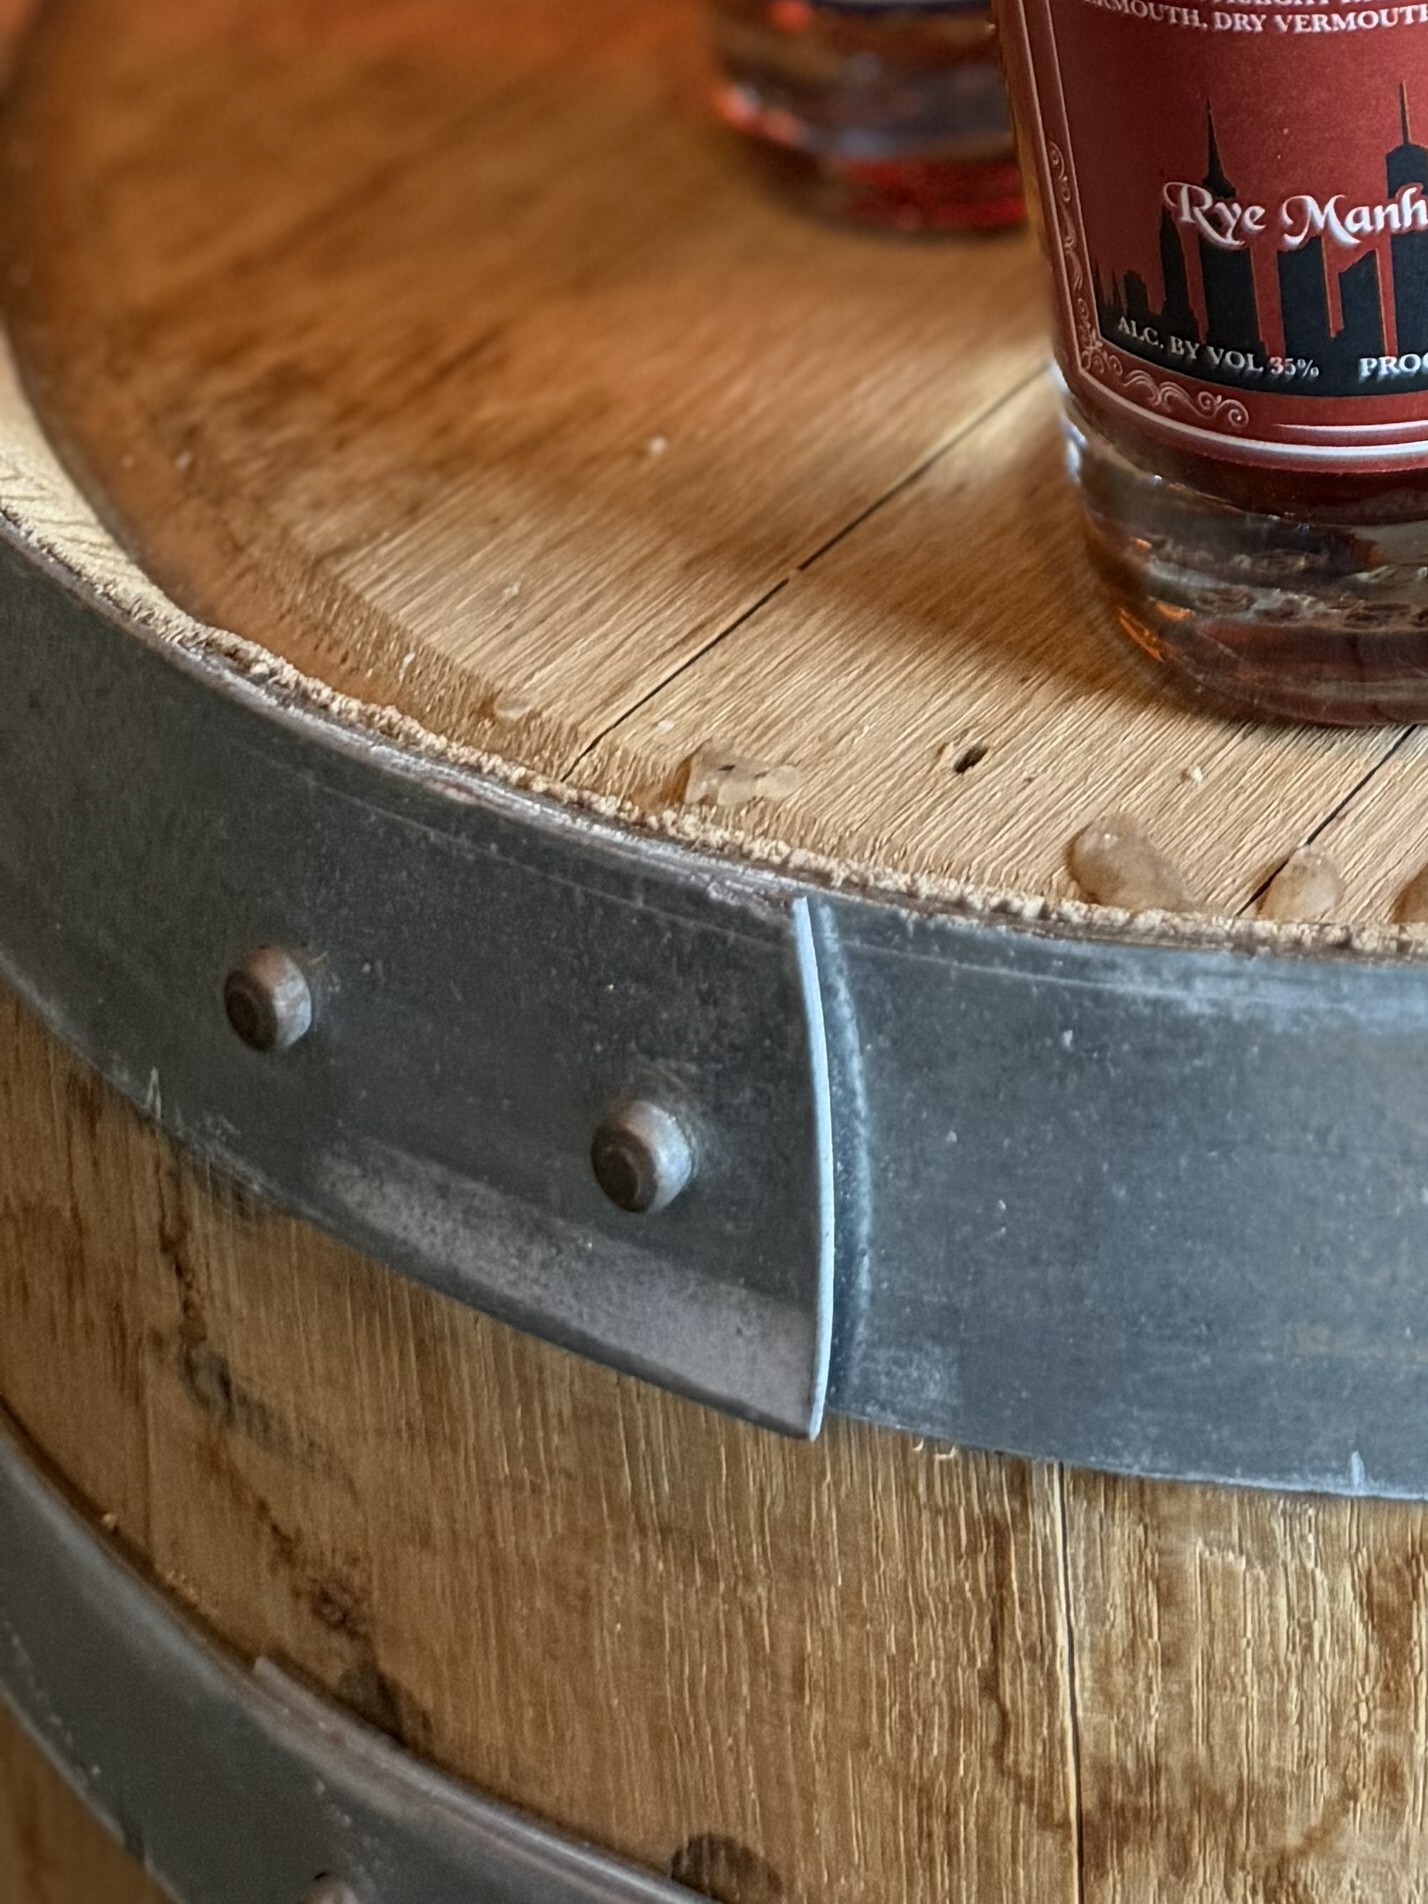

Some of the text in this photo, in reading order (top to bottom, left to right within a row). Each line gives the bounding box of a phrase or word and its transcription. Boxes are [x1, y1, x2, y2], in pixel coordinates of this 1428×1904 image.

[1212, 12, 1267, 32] DRY
[1162, 181, 1266, 248] Rye
[1117, 316, 1165, 351] ALC.
[1170, 337, 1203, 360] BY
[1207, 346, 1264, 375] VOL
[1270, 356, 1320, 380] 35%
